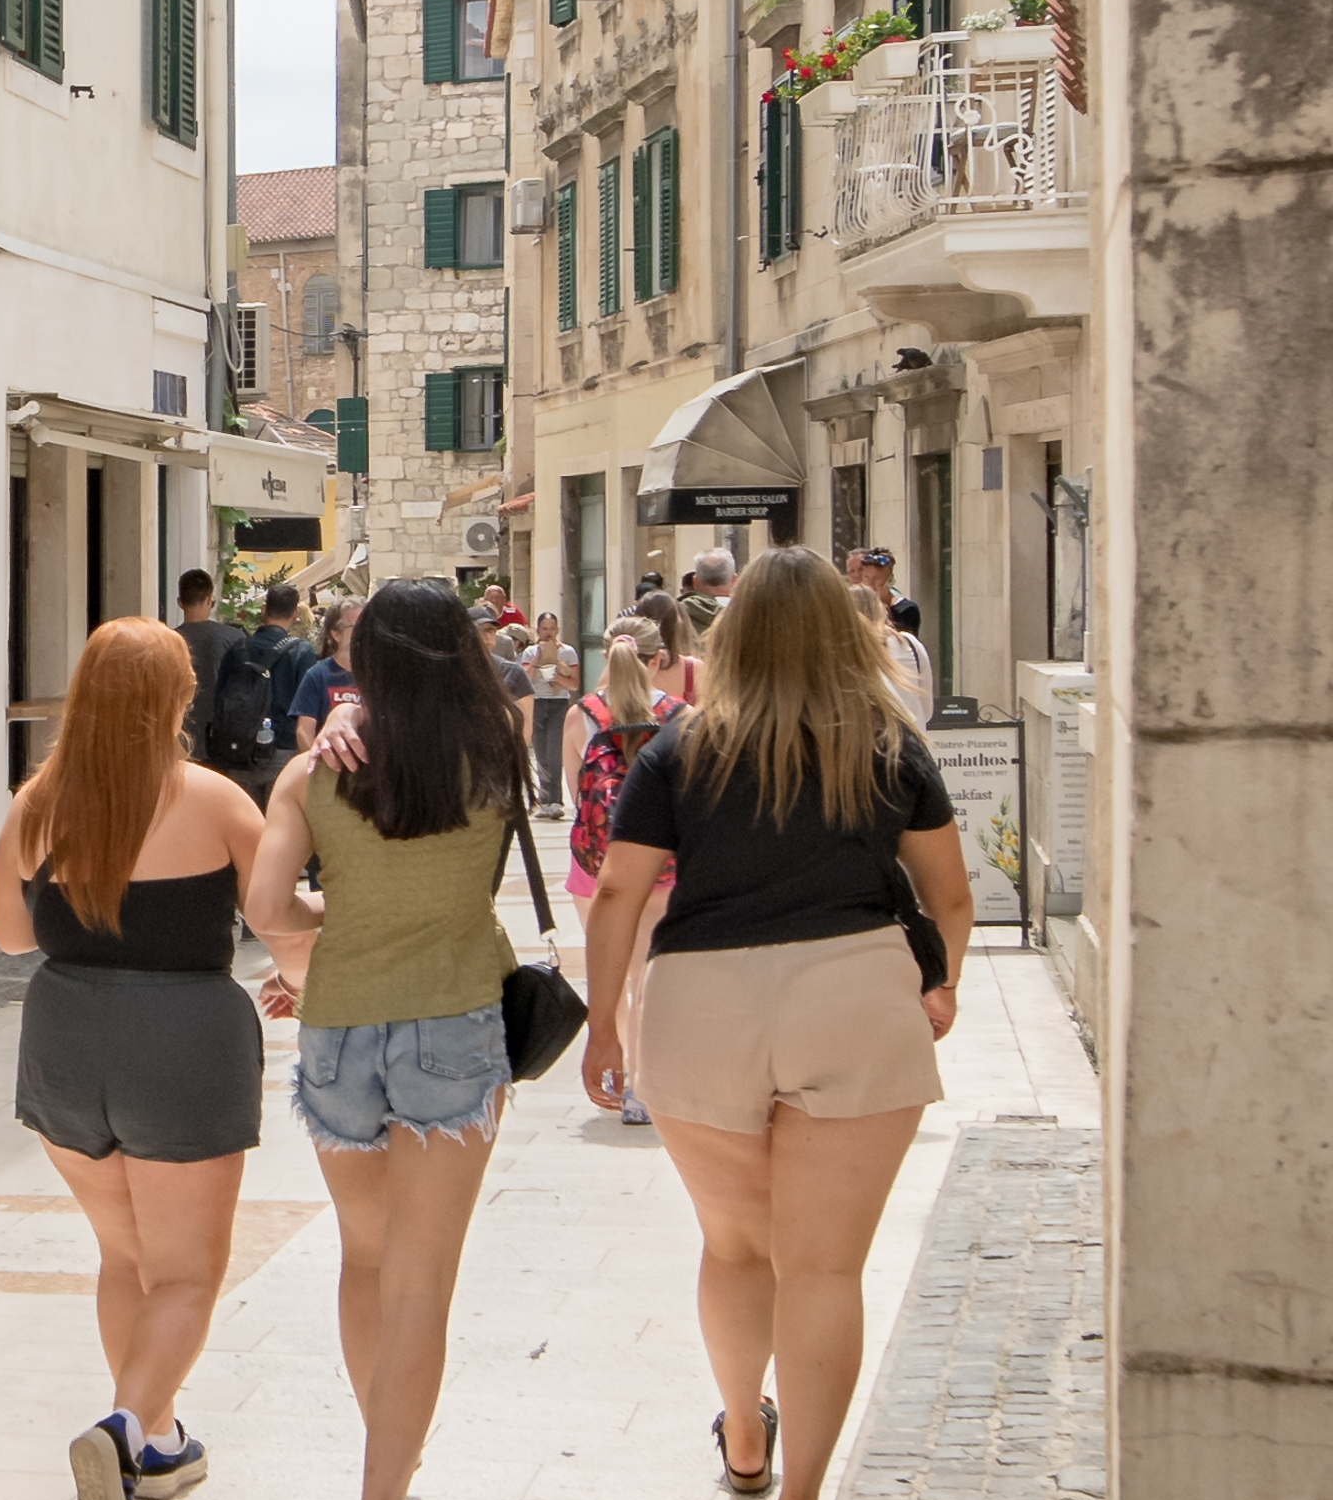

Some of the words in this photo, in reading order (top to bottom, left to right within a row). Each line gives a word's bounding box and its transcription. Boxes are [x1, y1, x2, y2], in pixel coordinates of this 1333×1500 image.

[721, 495, 761, 505] FRIZERSKI
[761, 494, 788, 504] SALON
[715, 507, 746, 517] BARBER
[746, 506, 769, 517] SHOP
[935, 752, 1008, 771] palathos
[948, 788, 993, 801] eakfast
